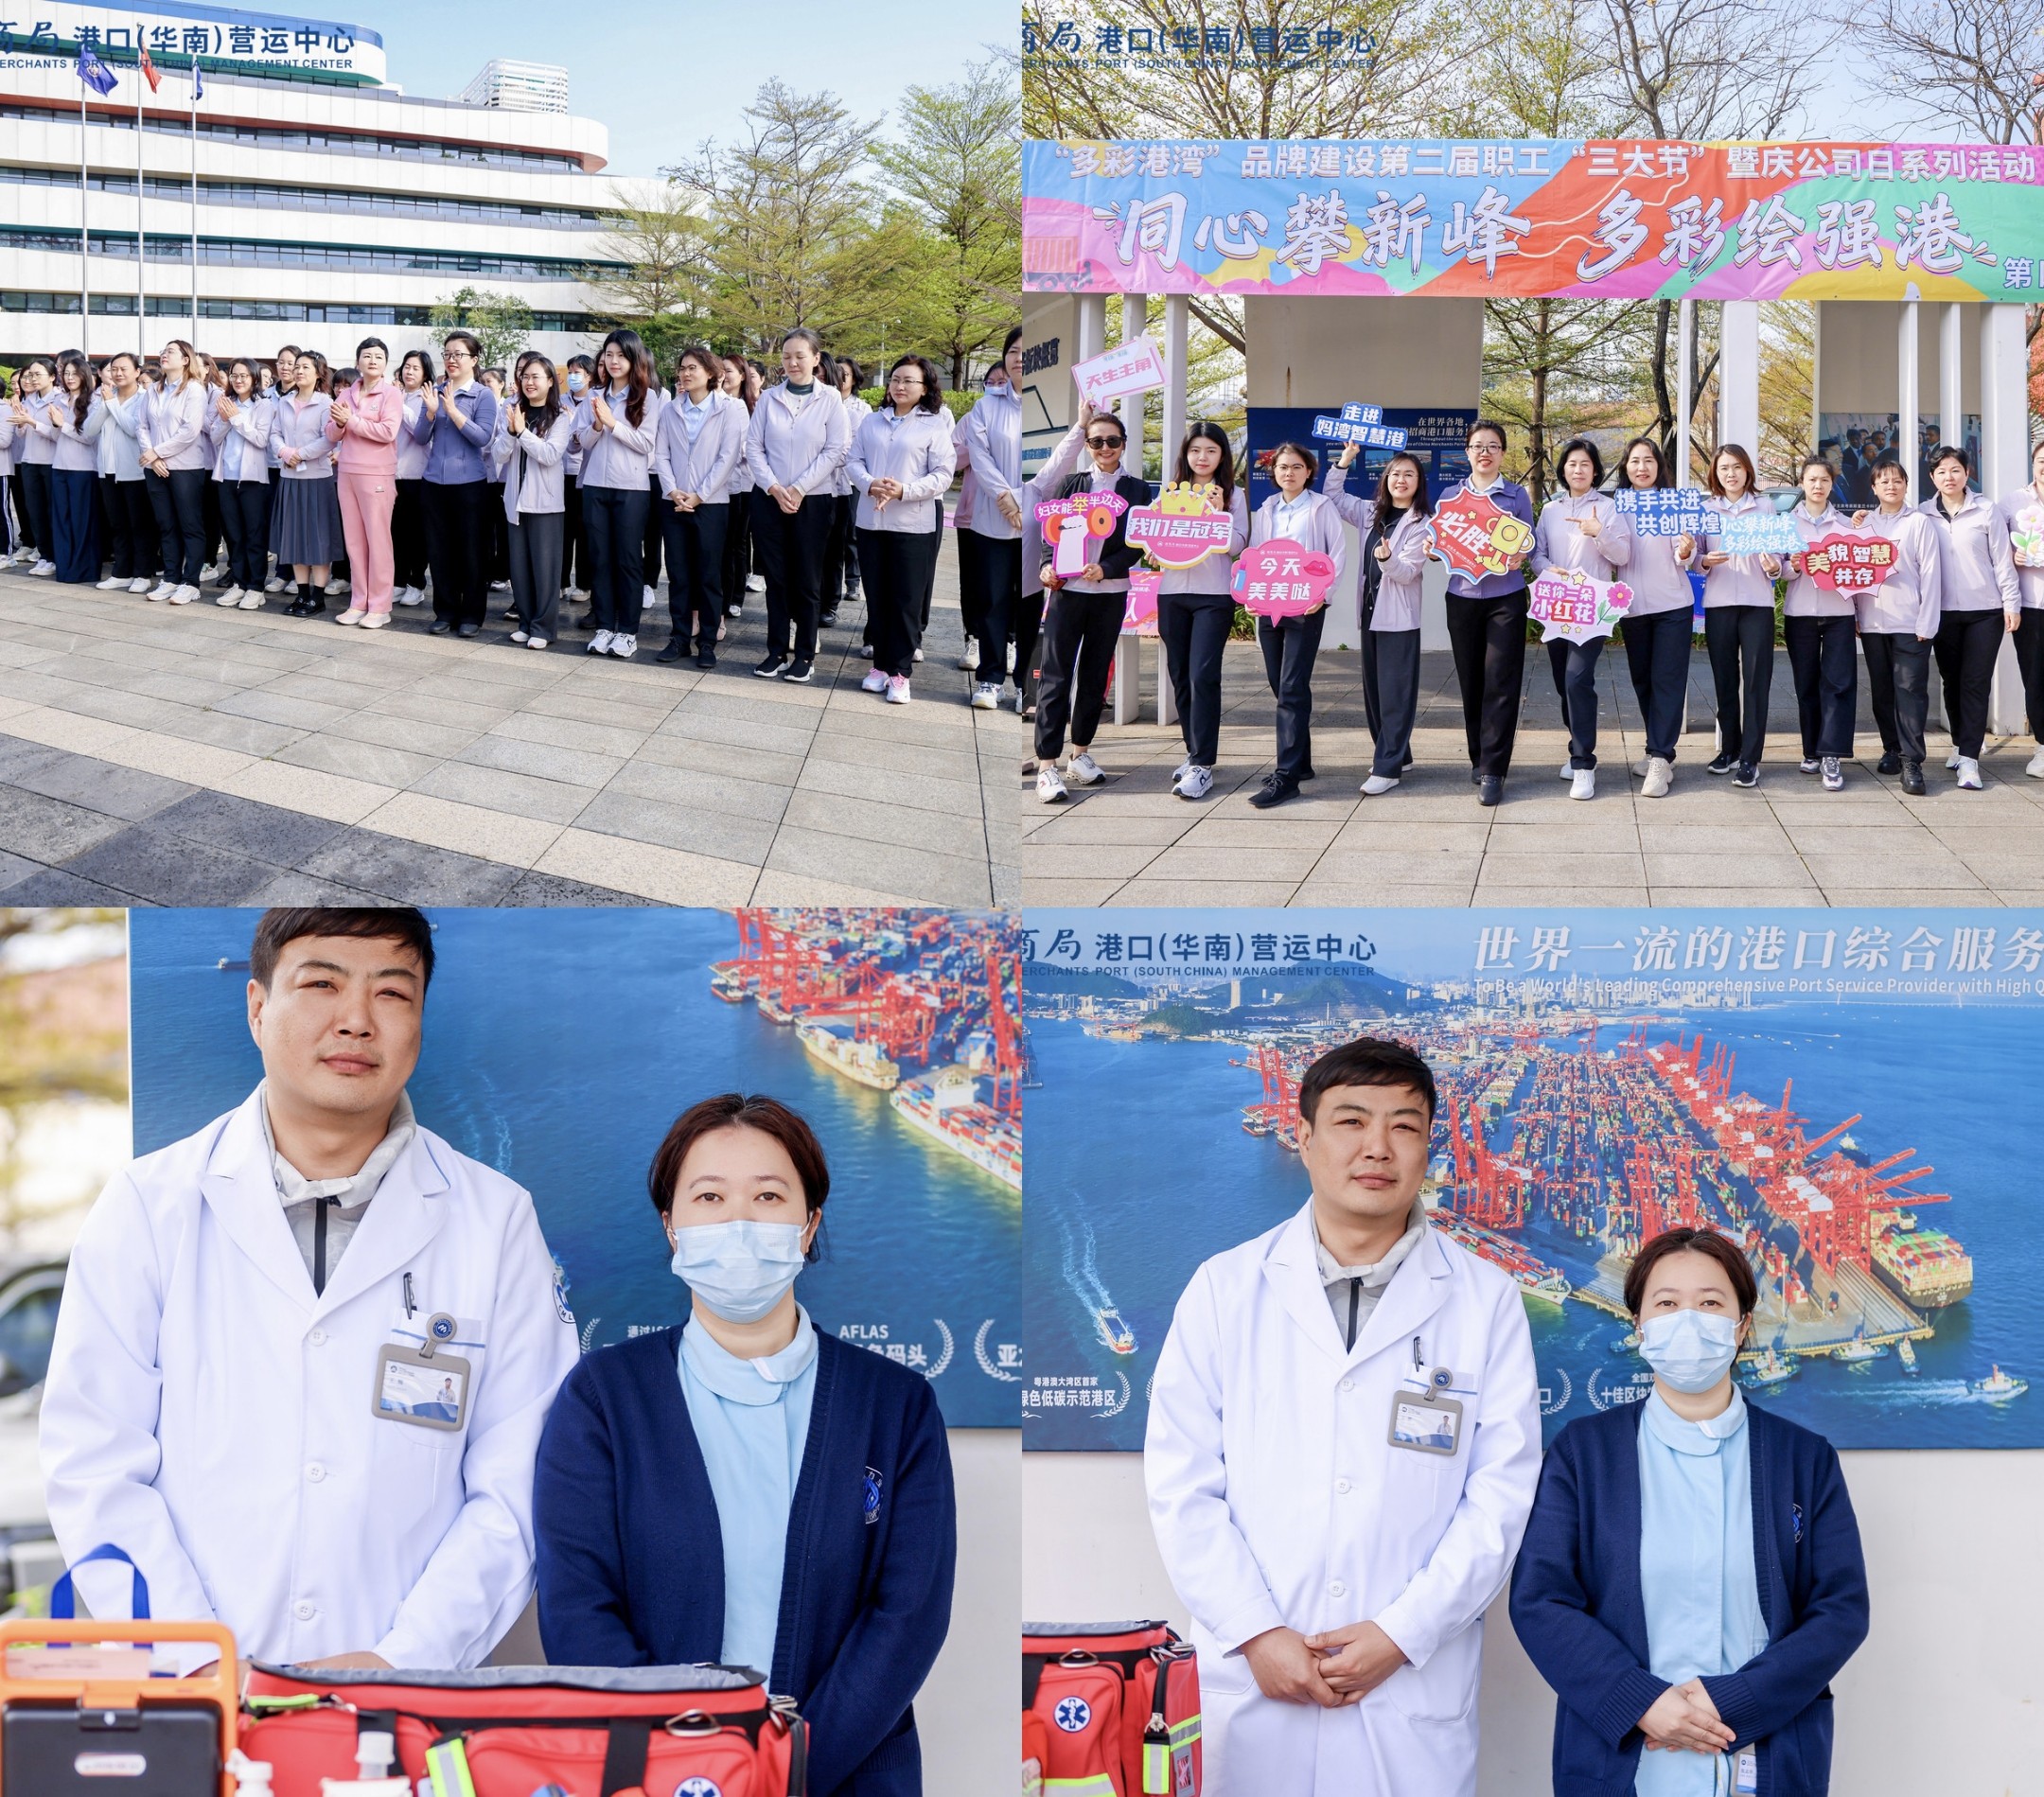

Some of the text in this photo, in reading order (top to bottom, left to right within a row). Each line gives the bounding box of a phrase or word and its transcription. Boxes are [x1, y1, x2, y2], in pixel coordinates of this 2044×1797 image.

[1113, 185, 1976, 282] 同心攀新峰 多彩绘强港
[1086, 358, 1152, 390] 天生主角
[1344, 405, 1379, 424] 走进
[1315, 419, 1404, 448] 妈湾智慧港
[1038, 493, 1124, 518] 妇女能举半边天
[1616, 490, 1700, 512] 携手共进
[1127, 518, 1232, 539] 我们是冠军
[1436, 511, 1491, 555] 必胜
[1637, 514, 1720, 535] 共创辉煌
[1724, 532, 1801, 552] 多彩绘强港
[1853, 544, 1892, 565] 智慧
[1260, 557, 1301, 576] 今天
[1835, 568, 1874, 585] 并存
[1247, 582, 1312, 600] 美美哒
[1538, 584, 1593, 602] 送你一朵
[1534, 599, 1593, 622] 小红花
[1473, 925, 2044, 972] 世界一流的港口综合服务
[1474, 978, 1490, 992] To
[1496, 979, 1514, 992] Be
[1519, 982, 1526, 992] a
[1530, 978, 1591, 992] World's
[1596, 977, 1657, 995] Leading
[1662, 977, 1786, 995] Comprehensive
[1789, 978, 1822, 992] Port
[1825, 978, 1884, 993] Service
[1888, 978, 1954, 993] Provider
[1958, 978, 1992, 994] with
[1997, 978, 2031, 996] High
[839, 1325, 889, 1339] AFLAS
[997, 1345, 1022, 1366] 亚
[1034, 1377, 1099, 1386] 粤港澳大湾区首家
[1600, 1386, 1652, 1404] 十佳区块
